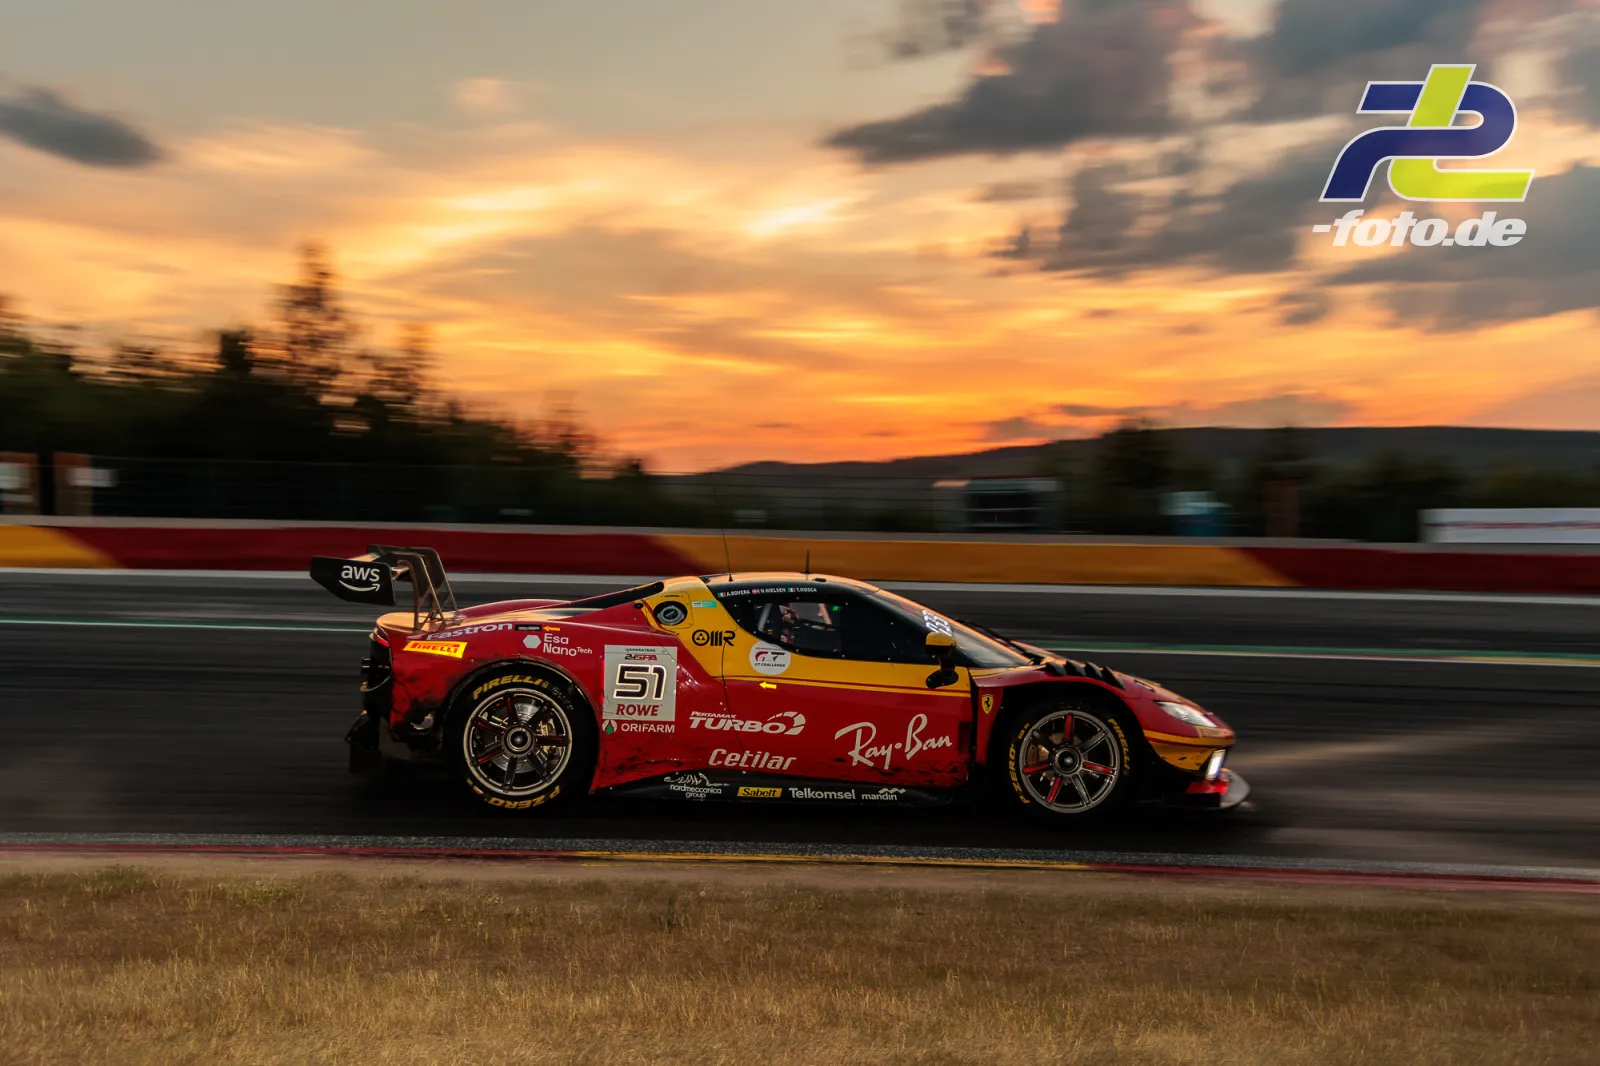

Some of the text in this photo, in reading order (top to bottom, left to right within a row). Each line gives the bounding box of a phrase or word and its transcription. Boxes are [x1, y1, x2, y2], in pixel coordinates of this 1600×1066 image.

[341, 565, 381, 582] aws
[726, 589, 751, 597] A.ROVERA
[426, 622, 513, 641] Fastron
[543, 633, 569, 645] Esa
[411, 641, 460, 654] PIRELLI
[472, 674, 544, 700] PIRELLI
[613, 663, 667, 701] 51
[615, 703, 660, 717] ROWE
[690, 711, 737, 719] PERTAMAX
[621, 722, 675, 733] ORIFARM
[708, 748, 797, 771] Cetilar
[669, 784, 722, 795] nordmeccanica
[742, 787, 778, 797] Sabelt
[788, 787, 856, 800] Telkomsel
[861, 790, 898, 801] mandiri
[685, 792, 707, 802] group
